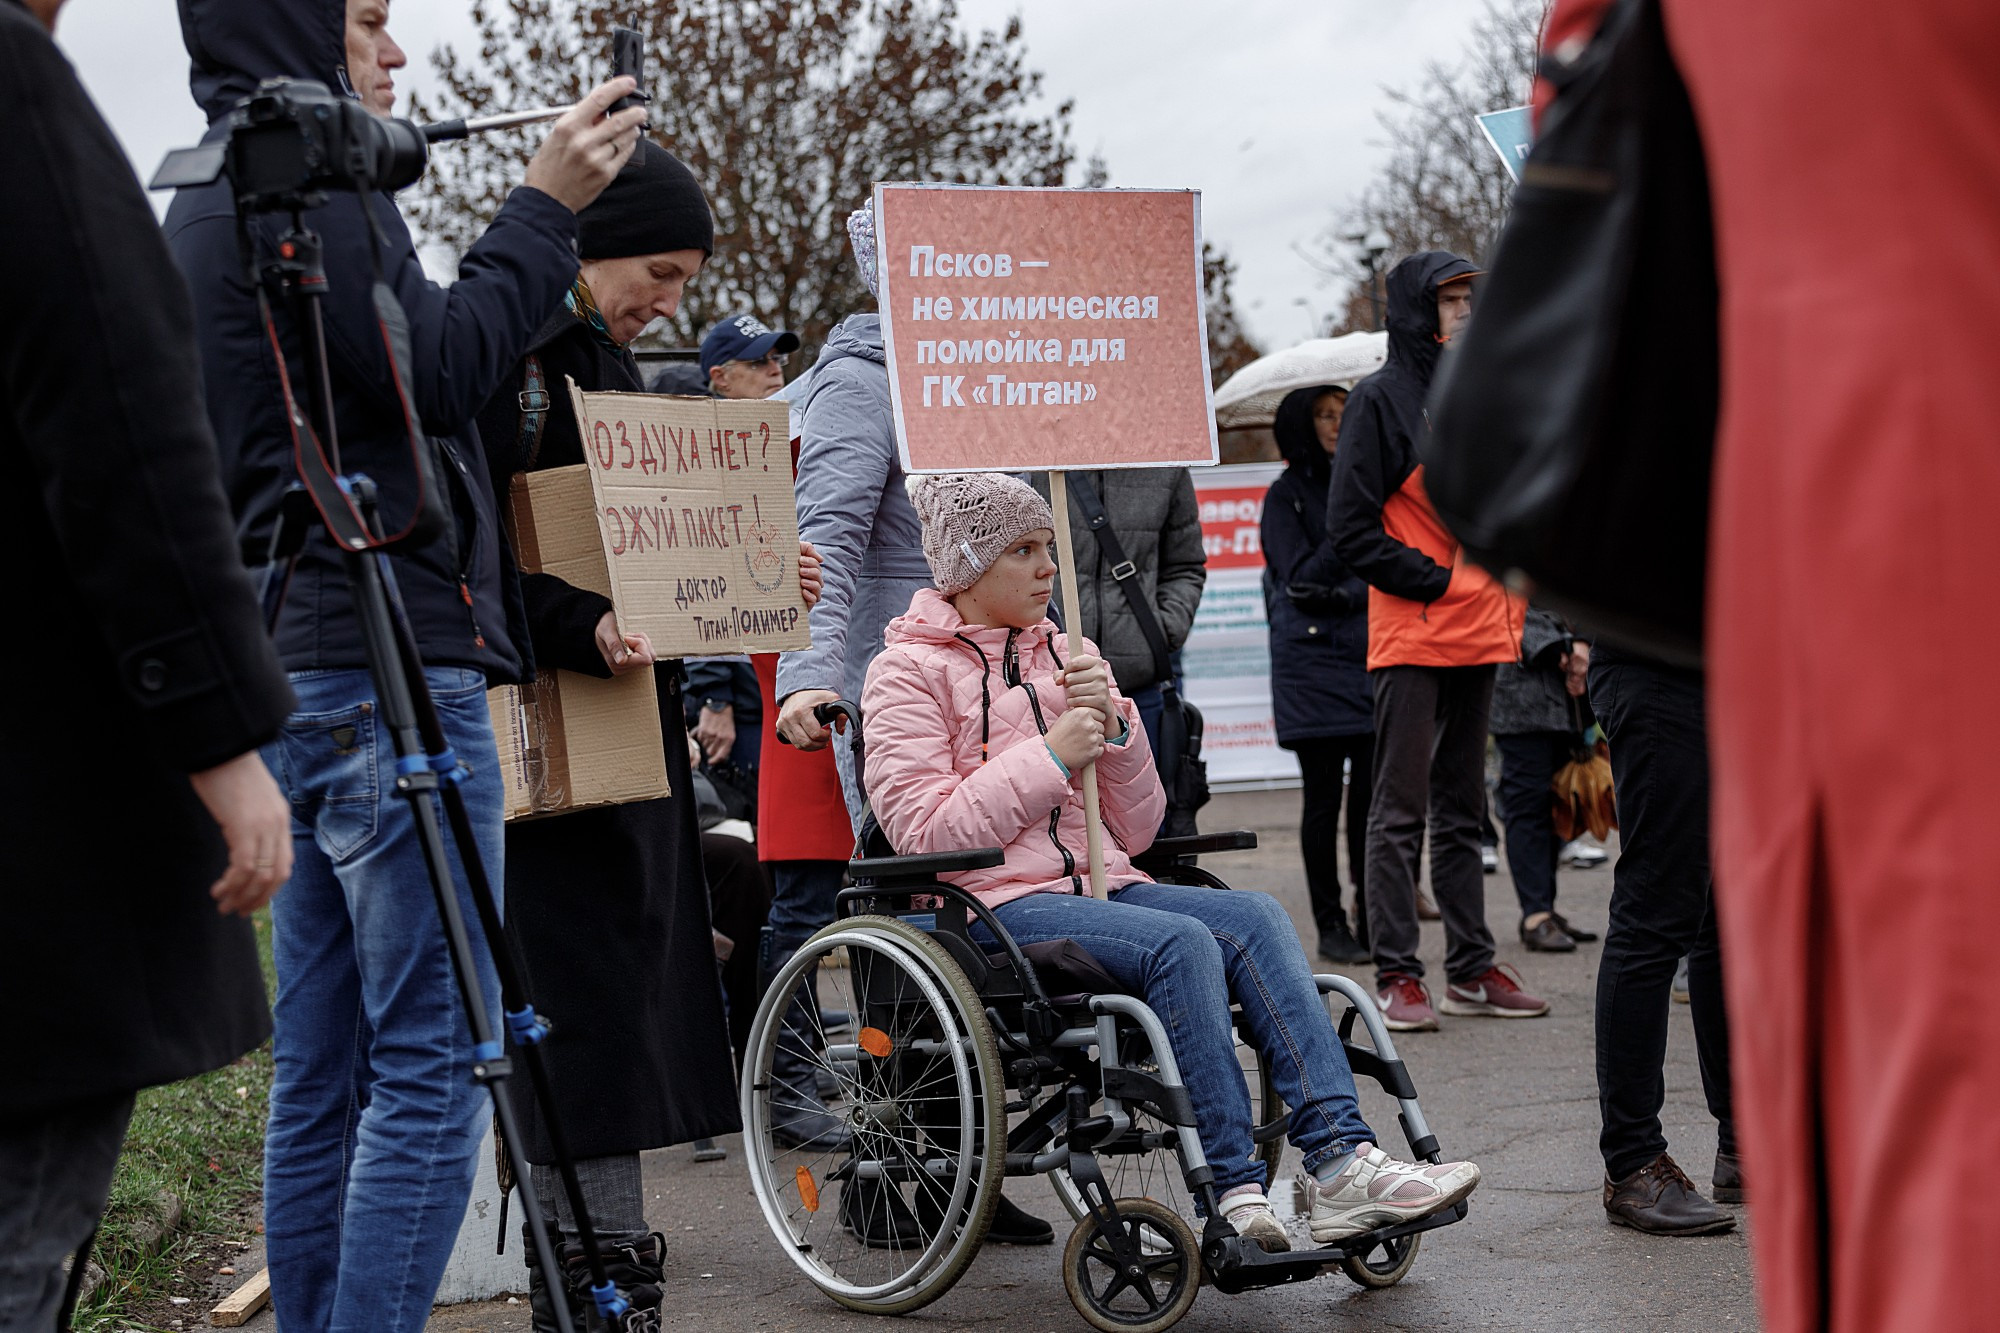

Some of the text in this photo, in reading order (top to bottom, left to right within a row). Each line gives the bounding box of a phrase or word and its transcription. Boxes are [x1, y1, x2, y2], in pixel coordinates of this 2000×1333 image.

[909, 245, 1013, 278] Псков
[912, 295, 1159, 321] не химическая
[917, 330, 1126, 367] помойка для
[923, 374, 1098, 408] ГК «Титан»
[674, 575, 727, 611] ДОКТОР
